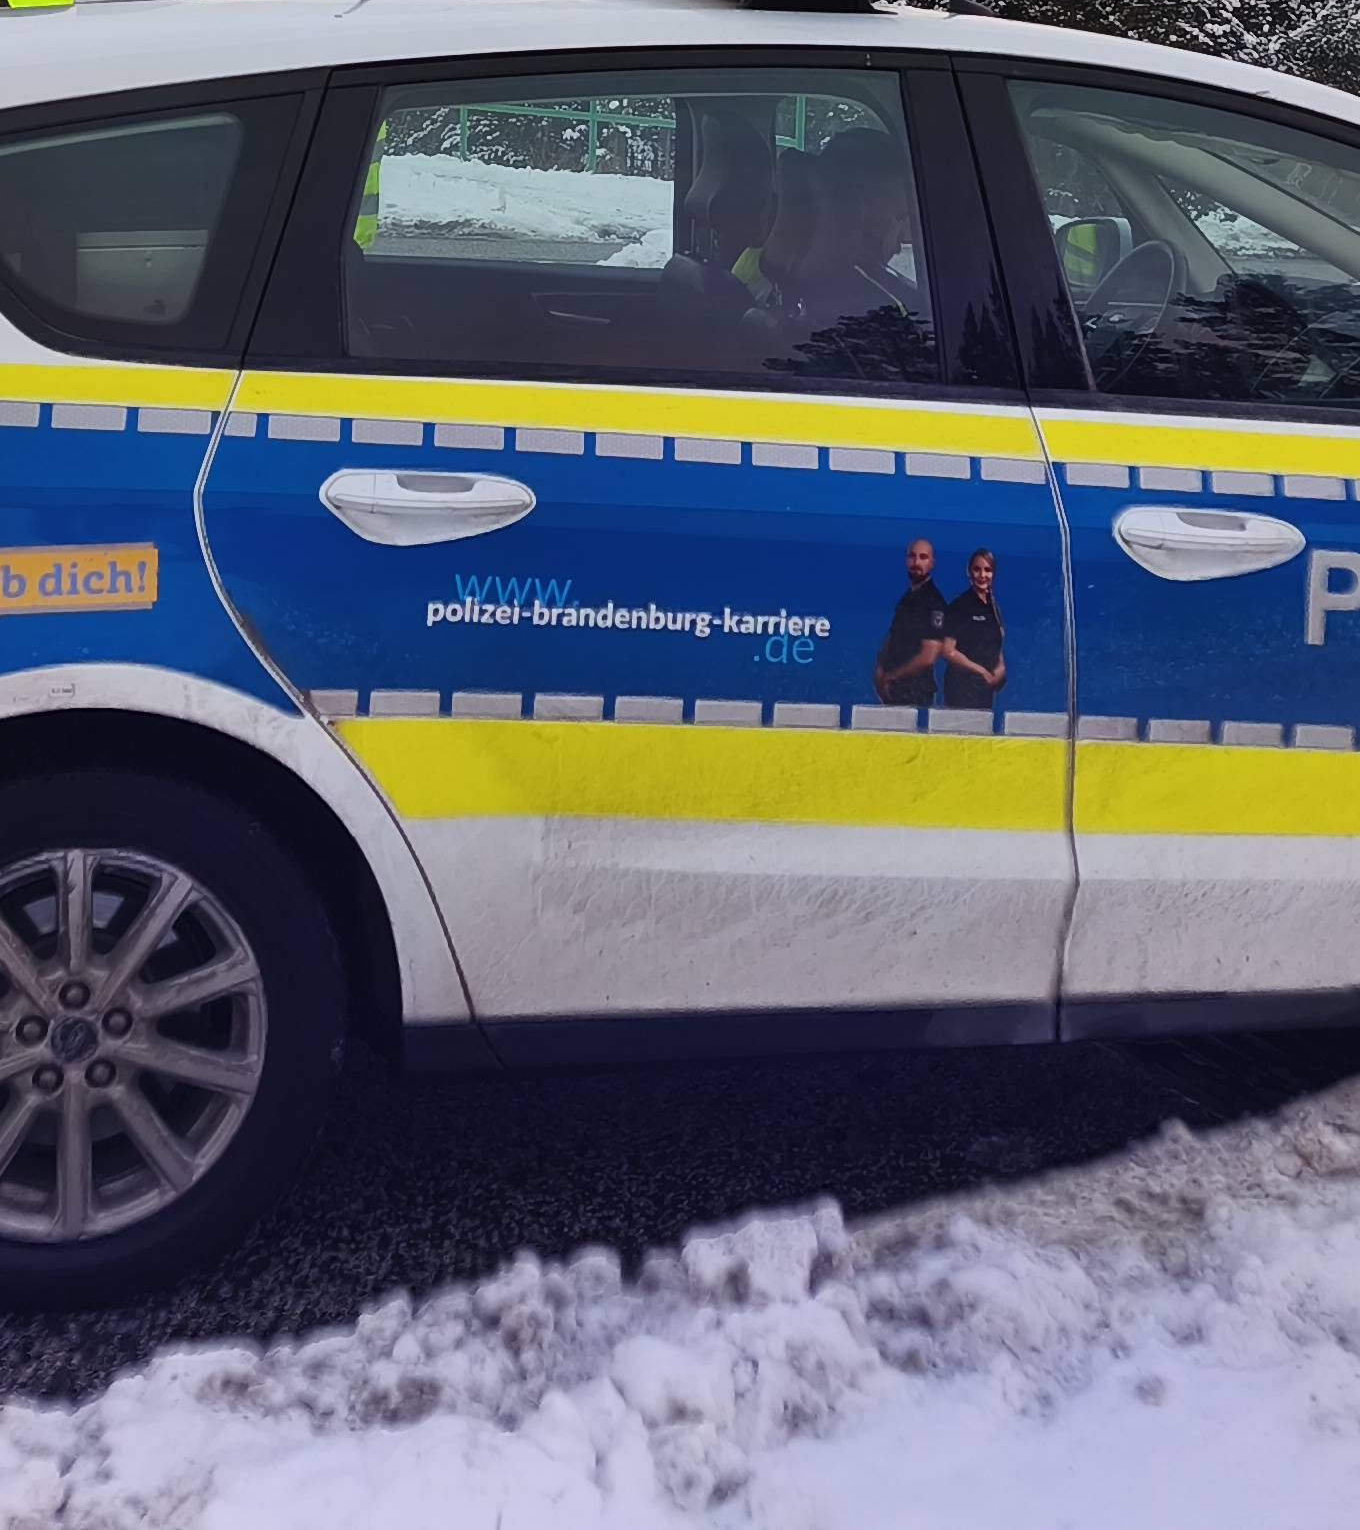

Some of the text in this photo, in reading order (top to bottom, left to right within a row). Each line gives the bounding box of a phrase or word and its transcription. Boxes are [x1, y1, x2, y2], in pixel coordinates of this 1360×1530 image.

[38, 561, 148, 596] dich!
[426, 596, 832, 638] polizei-brandenburg-karriere
[753, 631, 815, 664] .de
